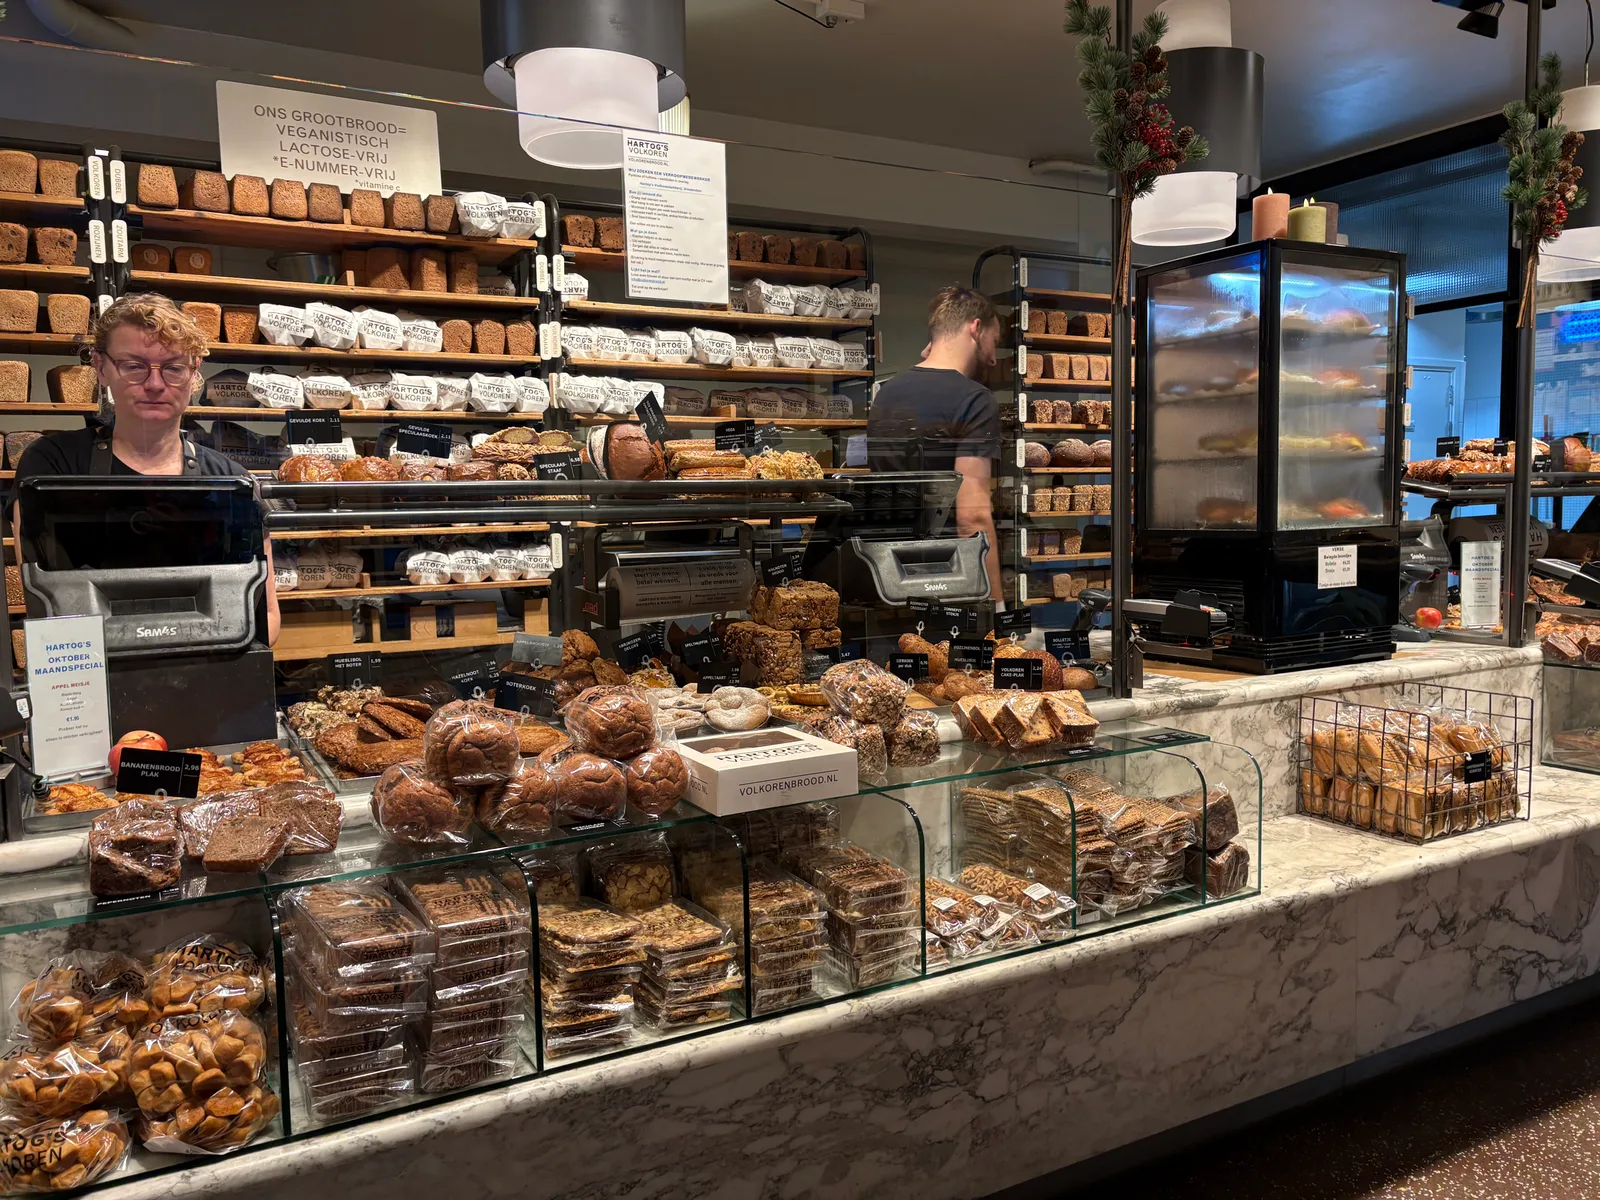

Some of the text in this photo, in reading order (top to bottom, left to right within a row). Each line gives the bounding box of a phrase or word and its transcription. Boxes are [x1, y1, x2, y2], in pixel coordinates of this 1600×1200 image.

[254, 105, 407, 135] ONS GROOTBROOD=
[277, 124, 389, 149] VEGANISTISCH
[627, 140, 669, 151] HARTOG'S
[629, 147, 668, 158] VOLKOREN
[280, 141, 388, 165] LACTOSE-VRIJ
[628, 158, 669, 166] VOLKORENBROOD.NL
[92, 160, 101, 197] VOLKOREN
[114, 168, 122, 195] DUBBEL
[509, 215, 535, 224] KOREN
[93, 225, 102, 258] ROZIJNEN
[116, 225, 124, 258] ZOUTARM
[268, 319, 306, 334] VOLKOREN
[313, 319, 350, 336] VOLKOREN
[362, 320, 398, 334] RTOG'S
[363, 326, 396, 340] VLKOREN
[252, 379, 299, 396] HARTOG'S
[252, 386, 296, 403] VOLKOREN
[305, 389, 345, 397] OLKOREN
[394, 393, 431, 402] OLKOREN
[480, 391, 511, 399] VOLKOREN
[522, 394, 544, 402] KOREN
[564, 391, 599, 400] VOLKOREN
[399, 428, 438, 439] SPECULAASKOEK
[408, 425, 430, 433] GEVULDE
[45, 641, 92, 652] HARTOG'S
[48, 653, 90, 664] OKTOBER
[34, 661, 104, 676] MAANDSPECIAL
[506, 681, 536, 691] BOTERKOEK
[120, 761, 181, 773] BANANENBROOD
[140, 770, 160, 778] PLAK
[739, 774, 838, 796] VOLKORENBROOD.NL
[0, 1130, 67, 1151] TOG'S
[0, 1147, 63, 1174] KOREN
